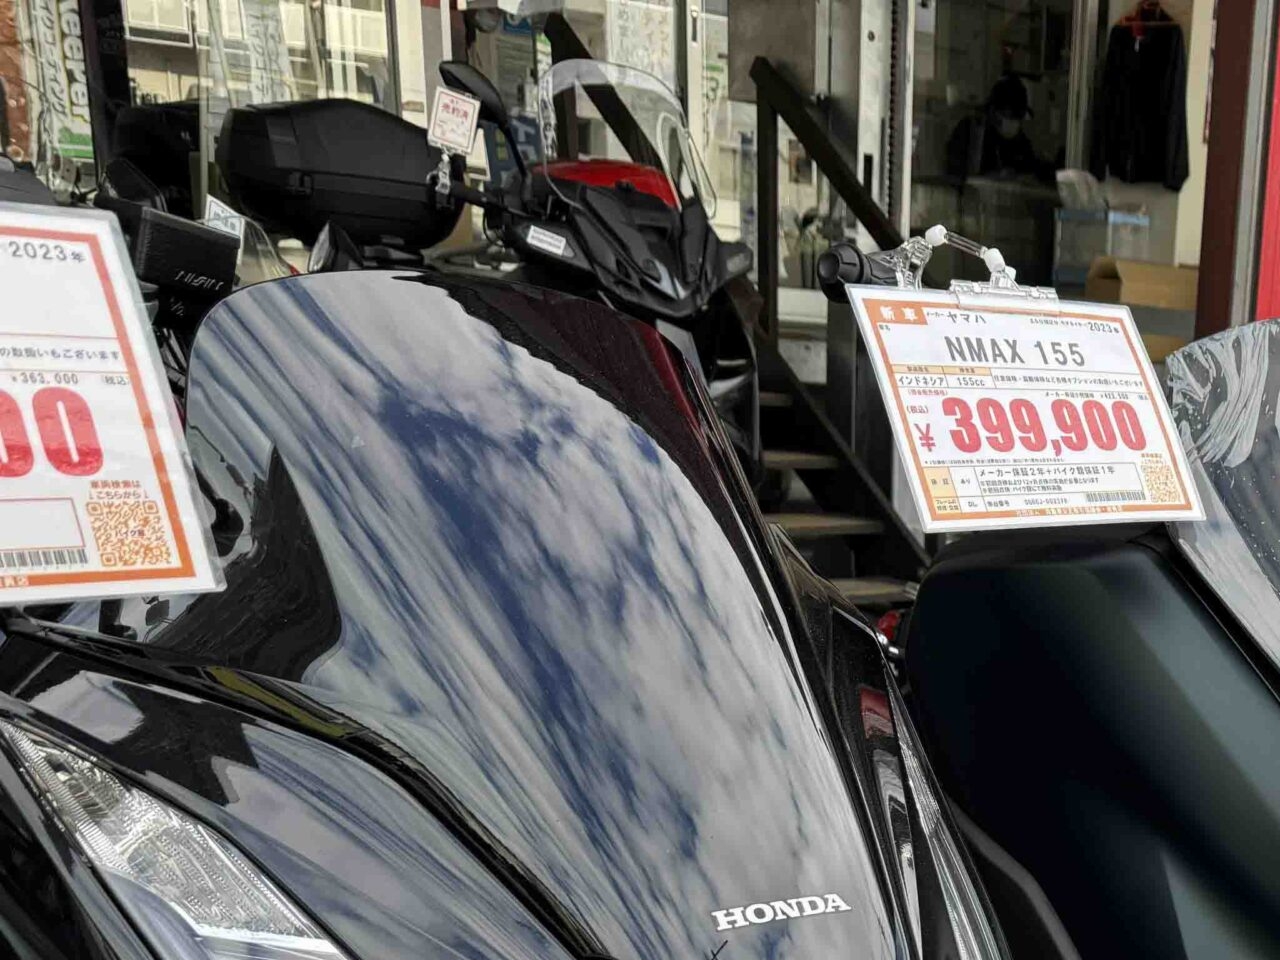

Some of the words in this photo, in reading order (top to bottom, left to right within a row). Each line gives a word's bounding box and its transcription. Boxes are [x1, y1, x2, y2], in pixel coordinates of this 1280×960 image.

[9, 240, 86, 262] 2023年
[880, 305, 919, 321] 新車
[947, 311, 987, 324] ヤマハ
[944, 335, 1025, 363] NMAX
[1033, 340, 1085, 367] 155
[898, 375, 945, 386] インドネシア
[956, 376, 986, 387] 155cc
[942, 397, 1147, 456] 399,900
[710, 892, 852, 932] HONDA
